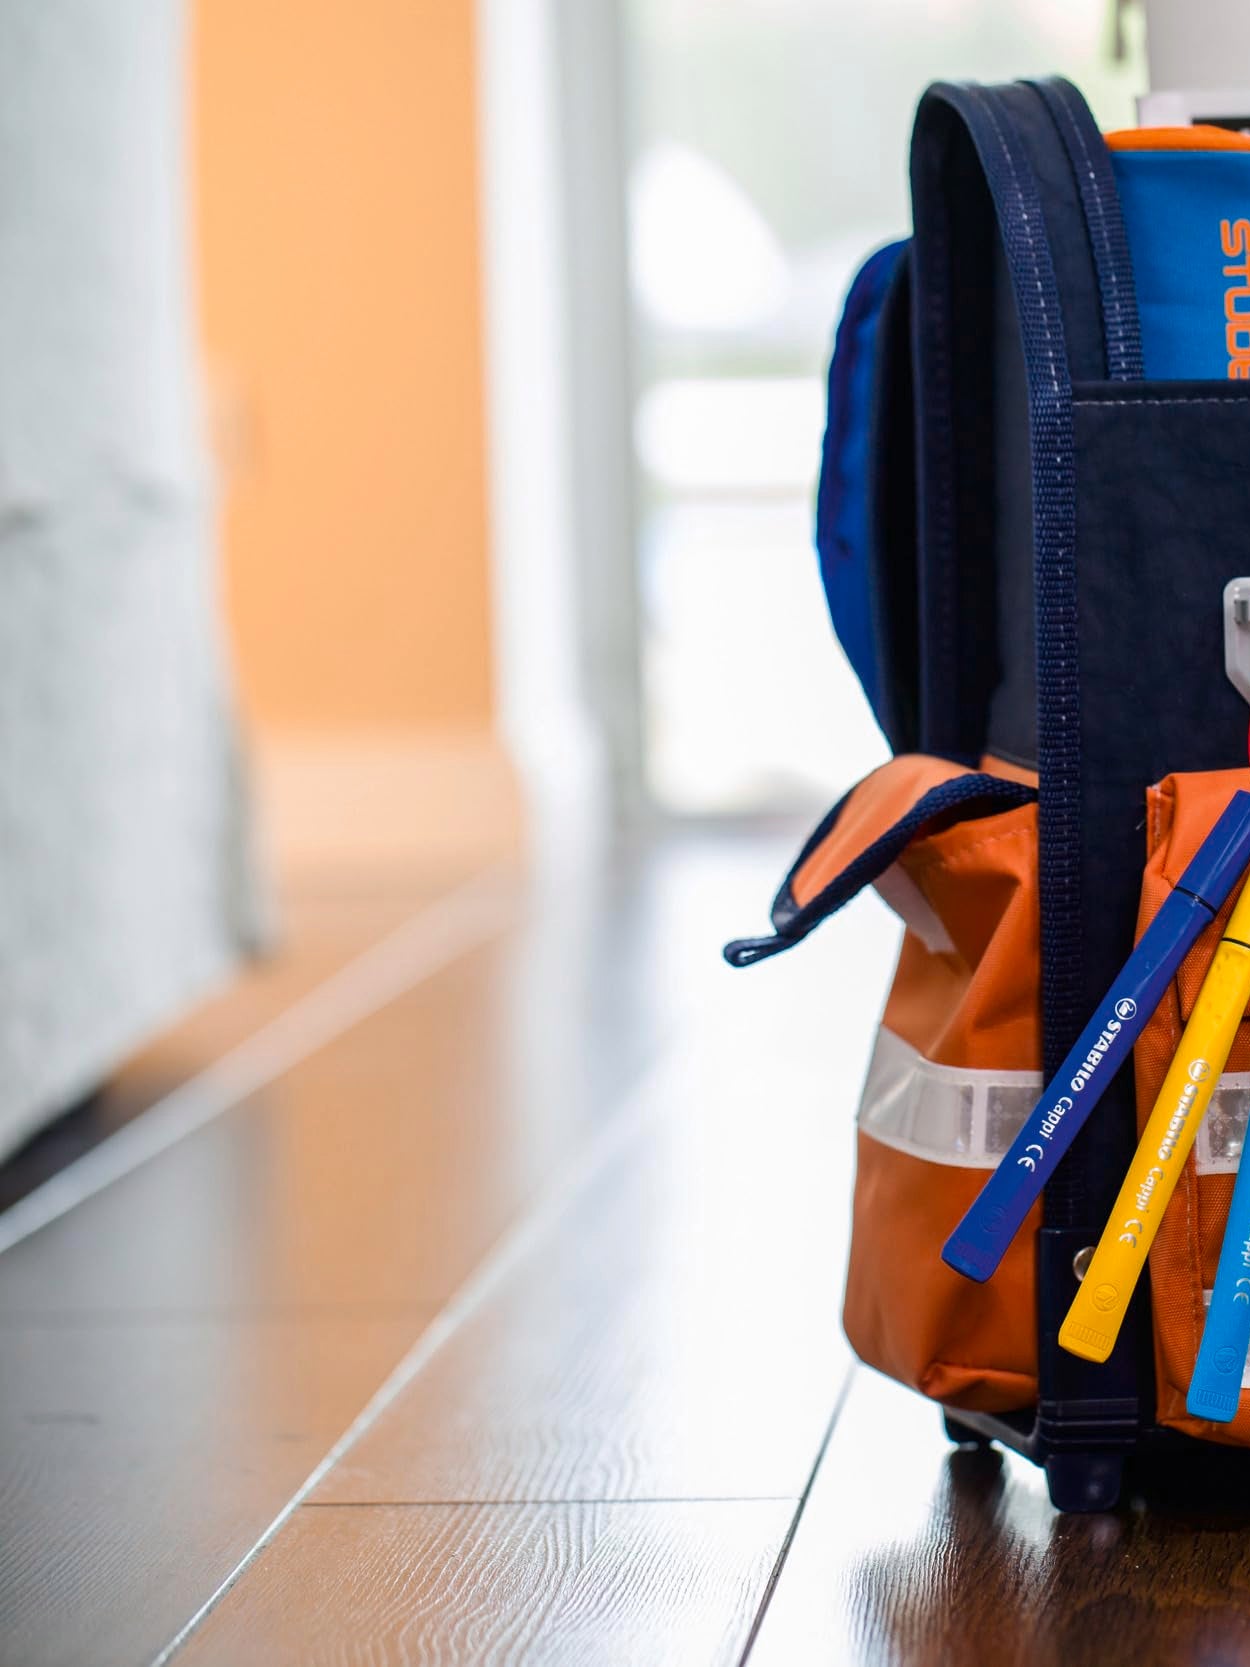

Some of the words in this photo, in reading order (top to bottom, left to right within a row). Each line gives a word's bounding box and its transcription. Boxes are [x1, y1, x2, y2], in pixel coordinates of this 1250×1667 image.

[1071, 1019, 1122, 1092] STABILO
[1039, 1096, 1073, 1140] Cappi
[1158, 1083, 1198, 1161] STABILO
[1136, 1166, 1164, 1213] Cappi
